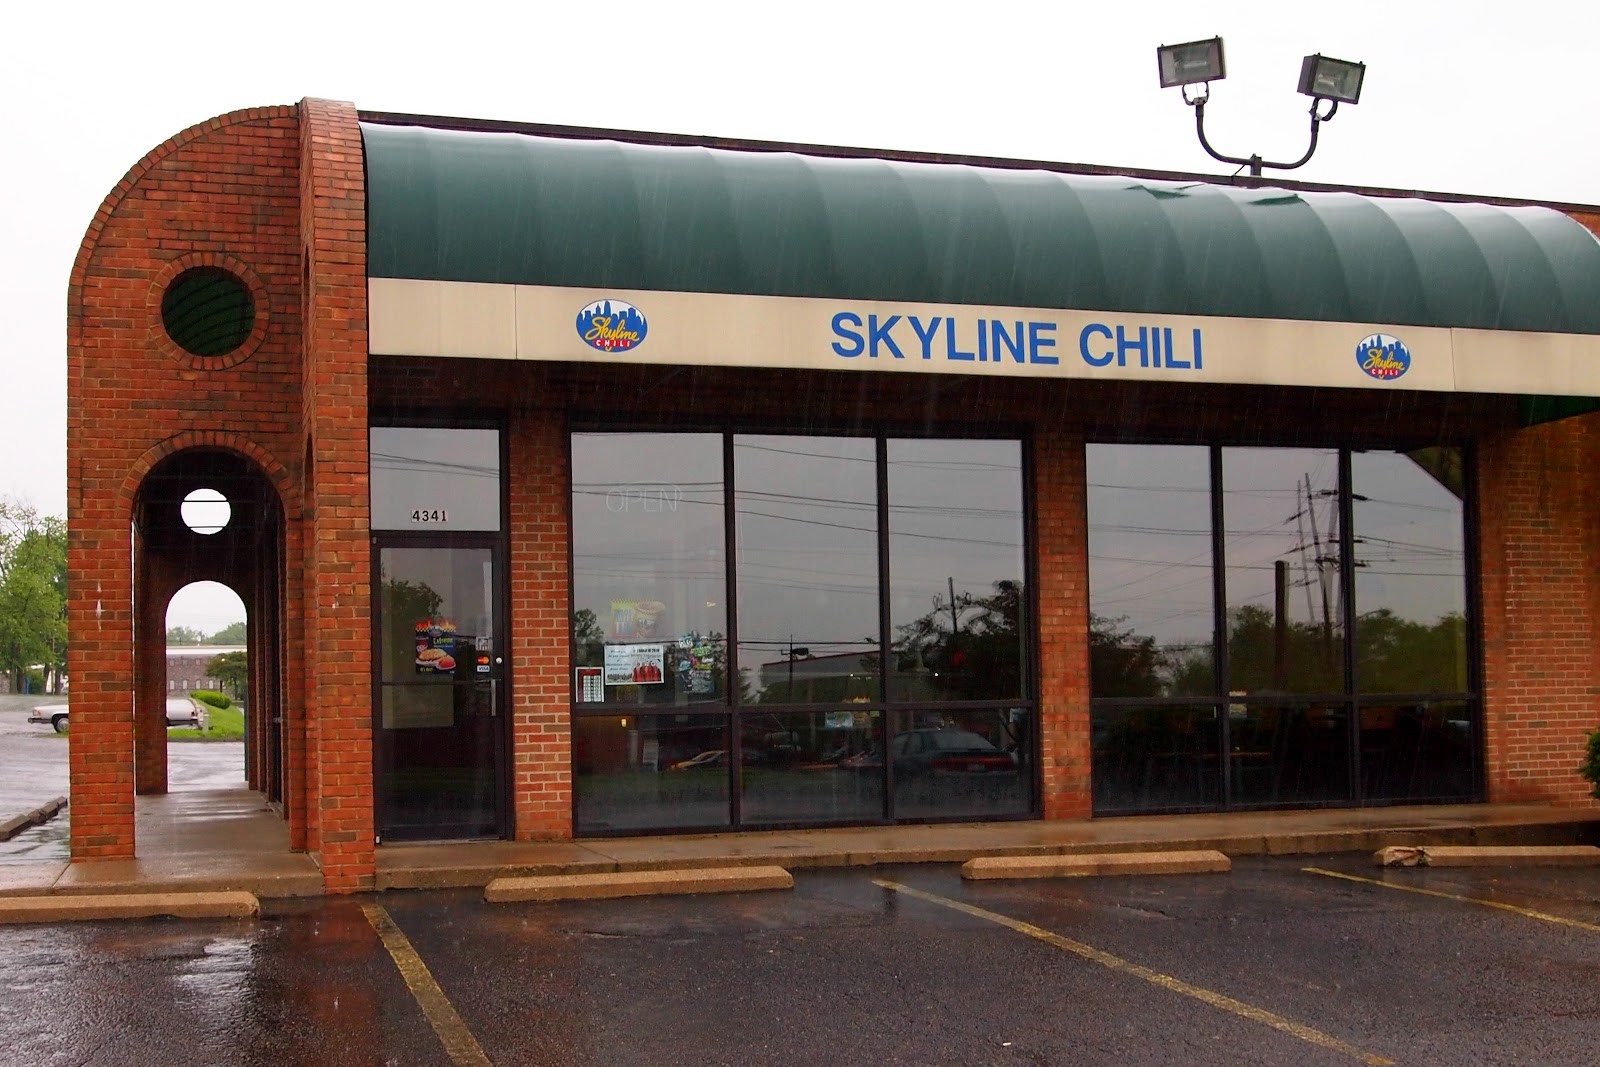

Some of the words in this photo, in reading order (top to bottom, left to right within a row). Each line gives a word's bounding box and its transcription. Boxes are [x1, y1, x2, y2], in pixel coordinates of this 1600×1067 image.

[585, 316, 639, 342] Skyline
[831, 312, 1059, 365] SKYLINE
[1079, 323, 1203, 369] CHILI
[1363, 349, 1405, 371] Skyline
[606, 488, 676, 512] OPEN
[412, 510, 447, 522] 4341
